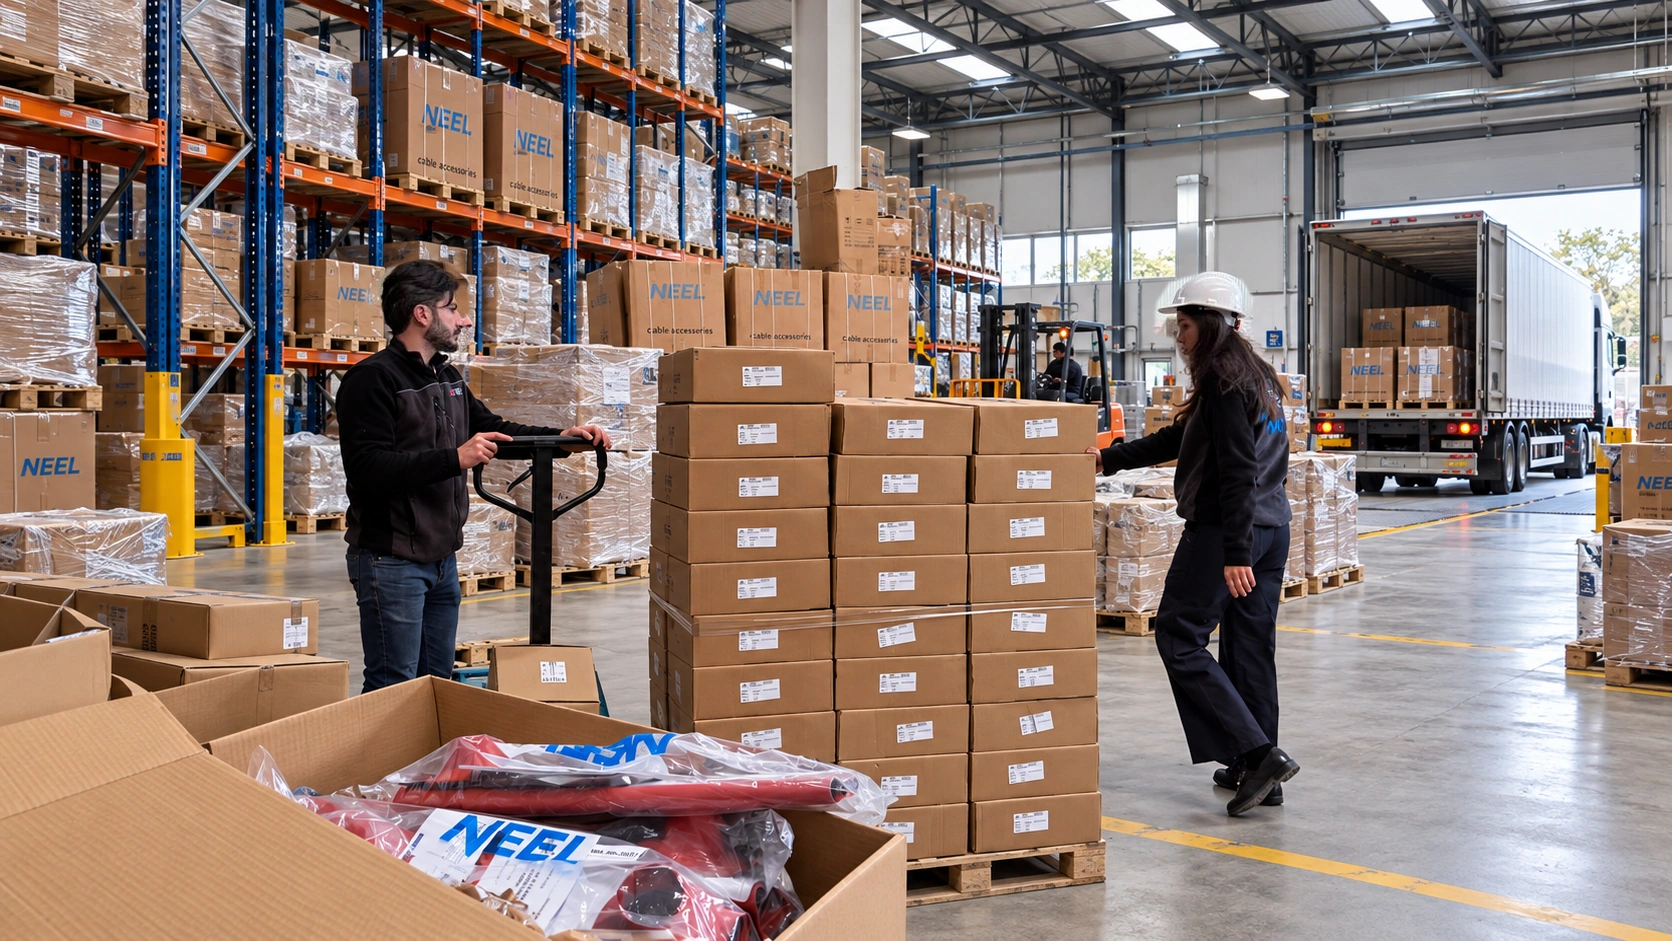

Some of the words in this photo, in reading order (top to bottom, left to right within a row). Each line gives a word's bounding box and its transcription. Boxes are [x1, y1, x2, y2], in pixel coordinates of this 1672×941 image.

[422, 103, 472, 136] NEEL
[514, 128, 554, 159] NEEL
[418, 156, 437, 169] cable
[650, 283, 706, 300] NEEL
[753, 289, 806, 307] NEEL
[847, 294, 892, 311] NEEL
[1369, 321, 1396, 331] NEEL
[1350, 364, 1385, 376] NEEL
[1406, 363, 1445, 375] NEEL
[20, 456, 80, 477] NEEL
[439, 814, 587, 865] NEEL
